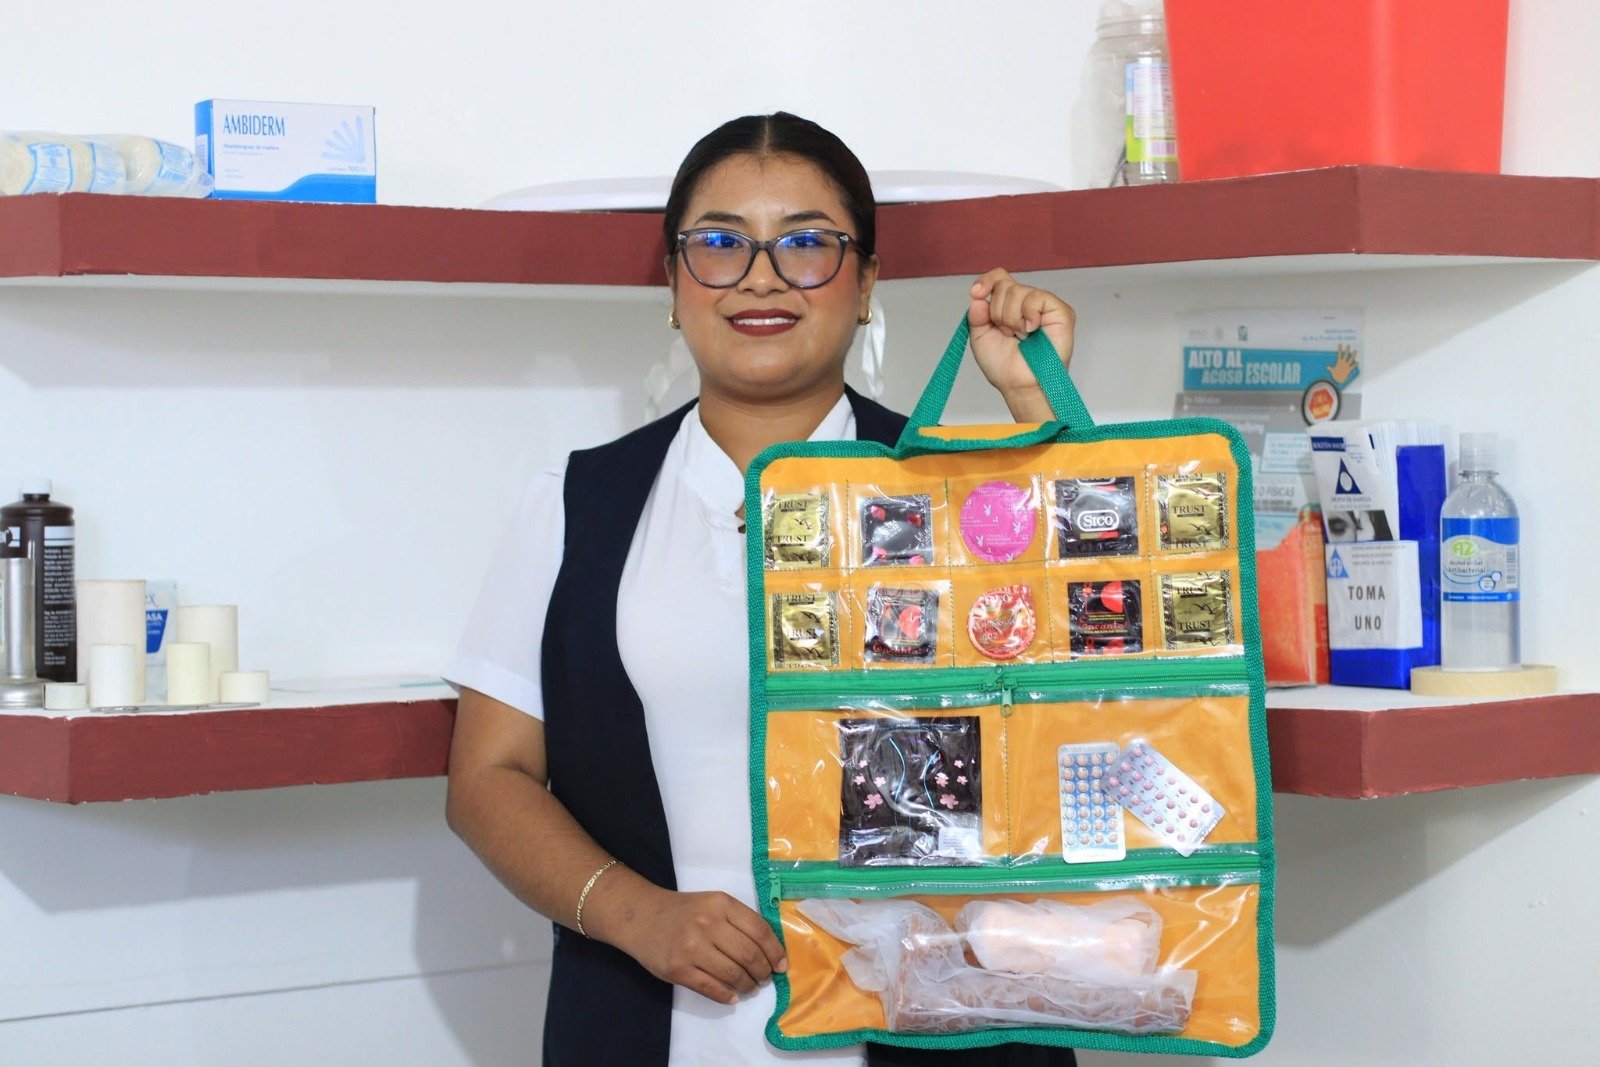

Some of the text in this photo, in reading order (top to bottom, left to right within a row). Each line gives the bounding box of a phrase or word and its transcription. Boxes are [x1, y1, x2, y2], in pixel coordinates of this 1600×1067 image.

[223, 114, 286, 137] AMBIDERM
[1188, 350, 1243, 369] ALTO AL
[1201, 362, 1301, 385] ACOSO ESCOLAR
[778, 500, 808, 510] TRUST
[1172, 505, 1207, 515] TRUST
[777, 534, 808, 544] TRUST
[1347, 585, 1386, 601] TOMA
[1177, 620, 1212, 631] TRUST
[1354, 614, 1382, 631] UNO
